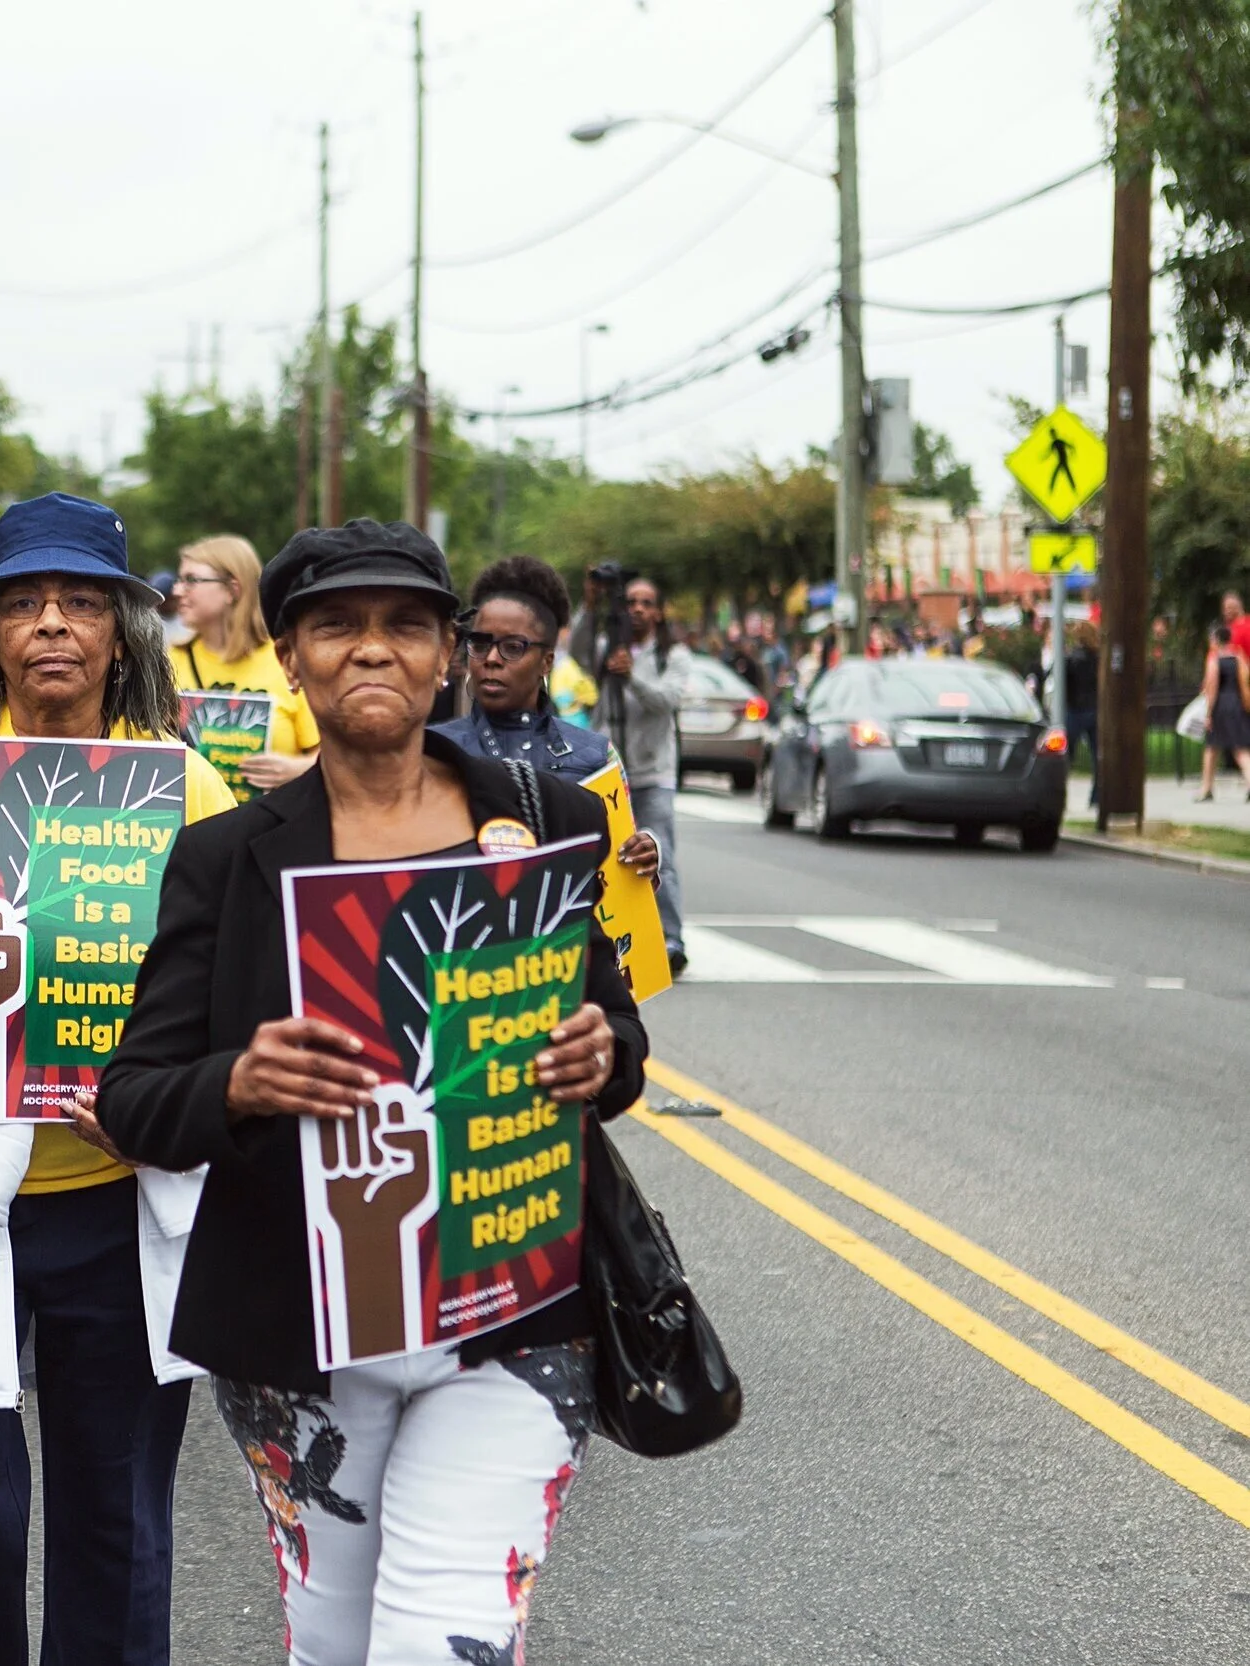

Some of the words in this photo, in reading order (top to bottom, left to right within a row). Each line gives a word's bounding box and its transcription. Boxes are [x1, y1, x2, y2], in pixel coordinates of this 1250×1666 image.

[36, 818, 173, 854] Healthy
[60, 858, 146, 885] Food
[75, 893, 104, 922] is
[110, 902, 131, 924] a
[56, 934, 149, 964] Basic
[38, 977, 136, 1005] Huma
[435, 945, 583, 1005] Healthy
[468, 994, 561, 1051] Food
[23, 1084, 99, 1093] #GROCERYWALK
[486, 1059, 519, 1097] is
[468, 1095, 560, 1152] Basic
[450, 1141, 572, 1205] Human
[471, 1188, 561, 1249] Right
